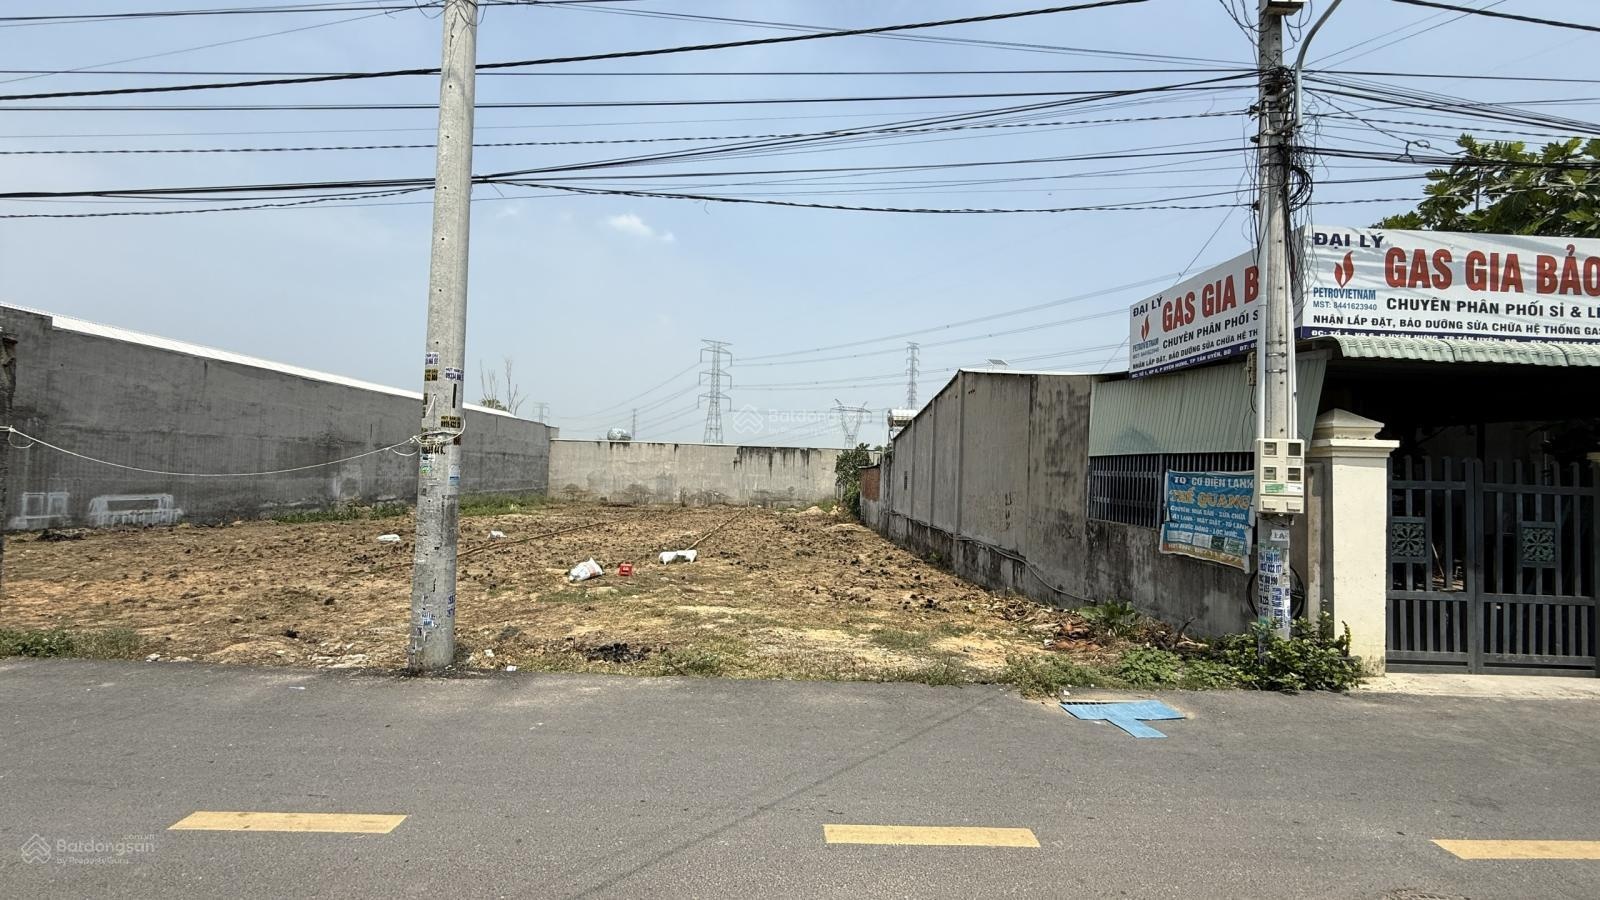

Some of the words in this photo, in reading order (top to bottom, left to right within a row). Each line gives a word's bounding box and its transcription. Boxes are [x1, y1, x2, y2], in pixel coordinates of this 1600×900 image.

[1312, 232, 1350, 249] ĐẠI
[1359, 232, 1385, 248] LÝ
[1384, 246, 1453, 290] GAS
[1465, 250, 1524, 293] GIA
[1536, 243, 1600, 297] BẢO
[1163, 291, 1196, 333] GAS
[1202, 274, 1237, 318] GIA
[1244, 265, 1259, 304] B
[1313, 287, 1377, 300] PETROVIETNAM
[1132, 303, 1148, 317] ĐẠI
[1151, 295, 1162, 310] LÝ
[1313, 300, 1331, 308] MST:
[1333, 301, 1378, 311] 8441623940
[1386, 296, 1451, 312] CHUYÊN
[1456, 299, 1499, 315] PHÂN
[1505, 300, 1544, 317] PHỐI
[1549, 302, 1564, 317] SỈ
[1570, 306, 1581, 318] &
[1162, 331, 1194, 349] CHUYÊN
[1196, 321, 1221, 338] PHÂN
[1224, 309, 1249, 330] PHỐI
[1252, 309, 1259, 321] S
[1248, 328, 1258, 338] TH
[1313, 314, 1343, 326] NHẬN
[1347, 313, 1368, 325] LẮP
[1371, 315, 1396, 328] ĐẶT,
[1400, 316, 1422, 328] BẢO
[1425, 318, 1463, 330] DƯỠNG
[1466, 319, 1488, 331] SỬA
[1491, 321, 1522, 332] CHỮA
[1526, 323, 1540, 335] HỆ
[1544, 323, 1580, 335] THỐNG
